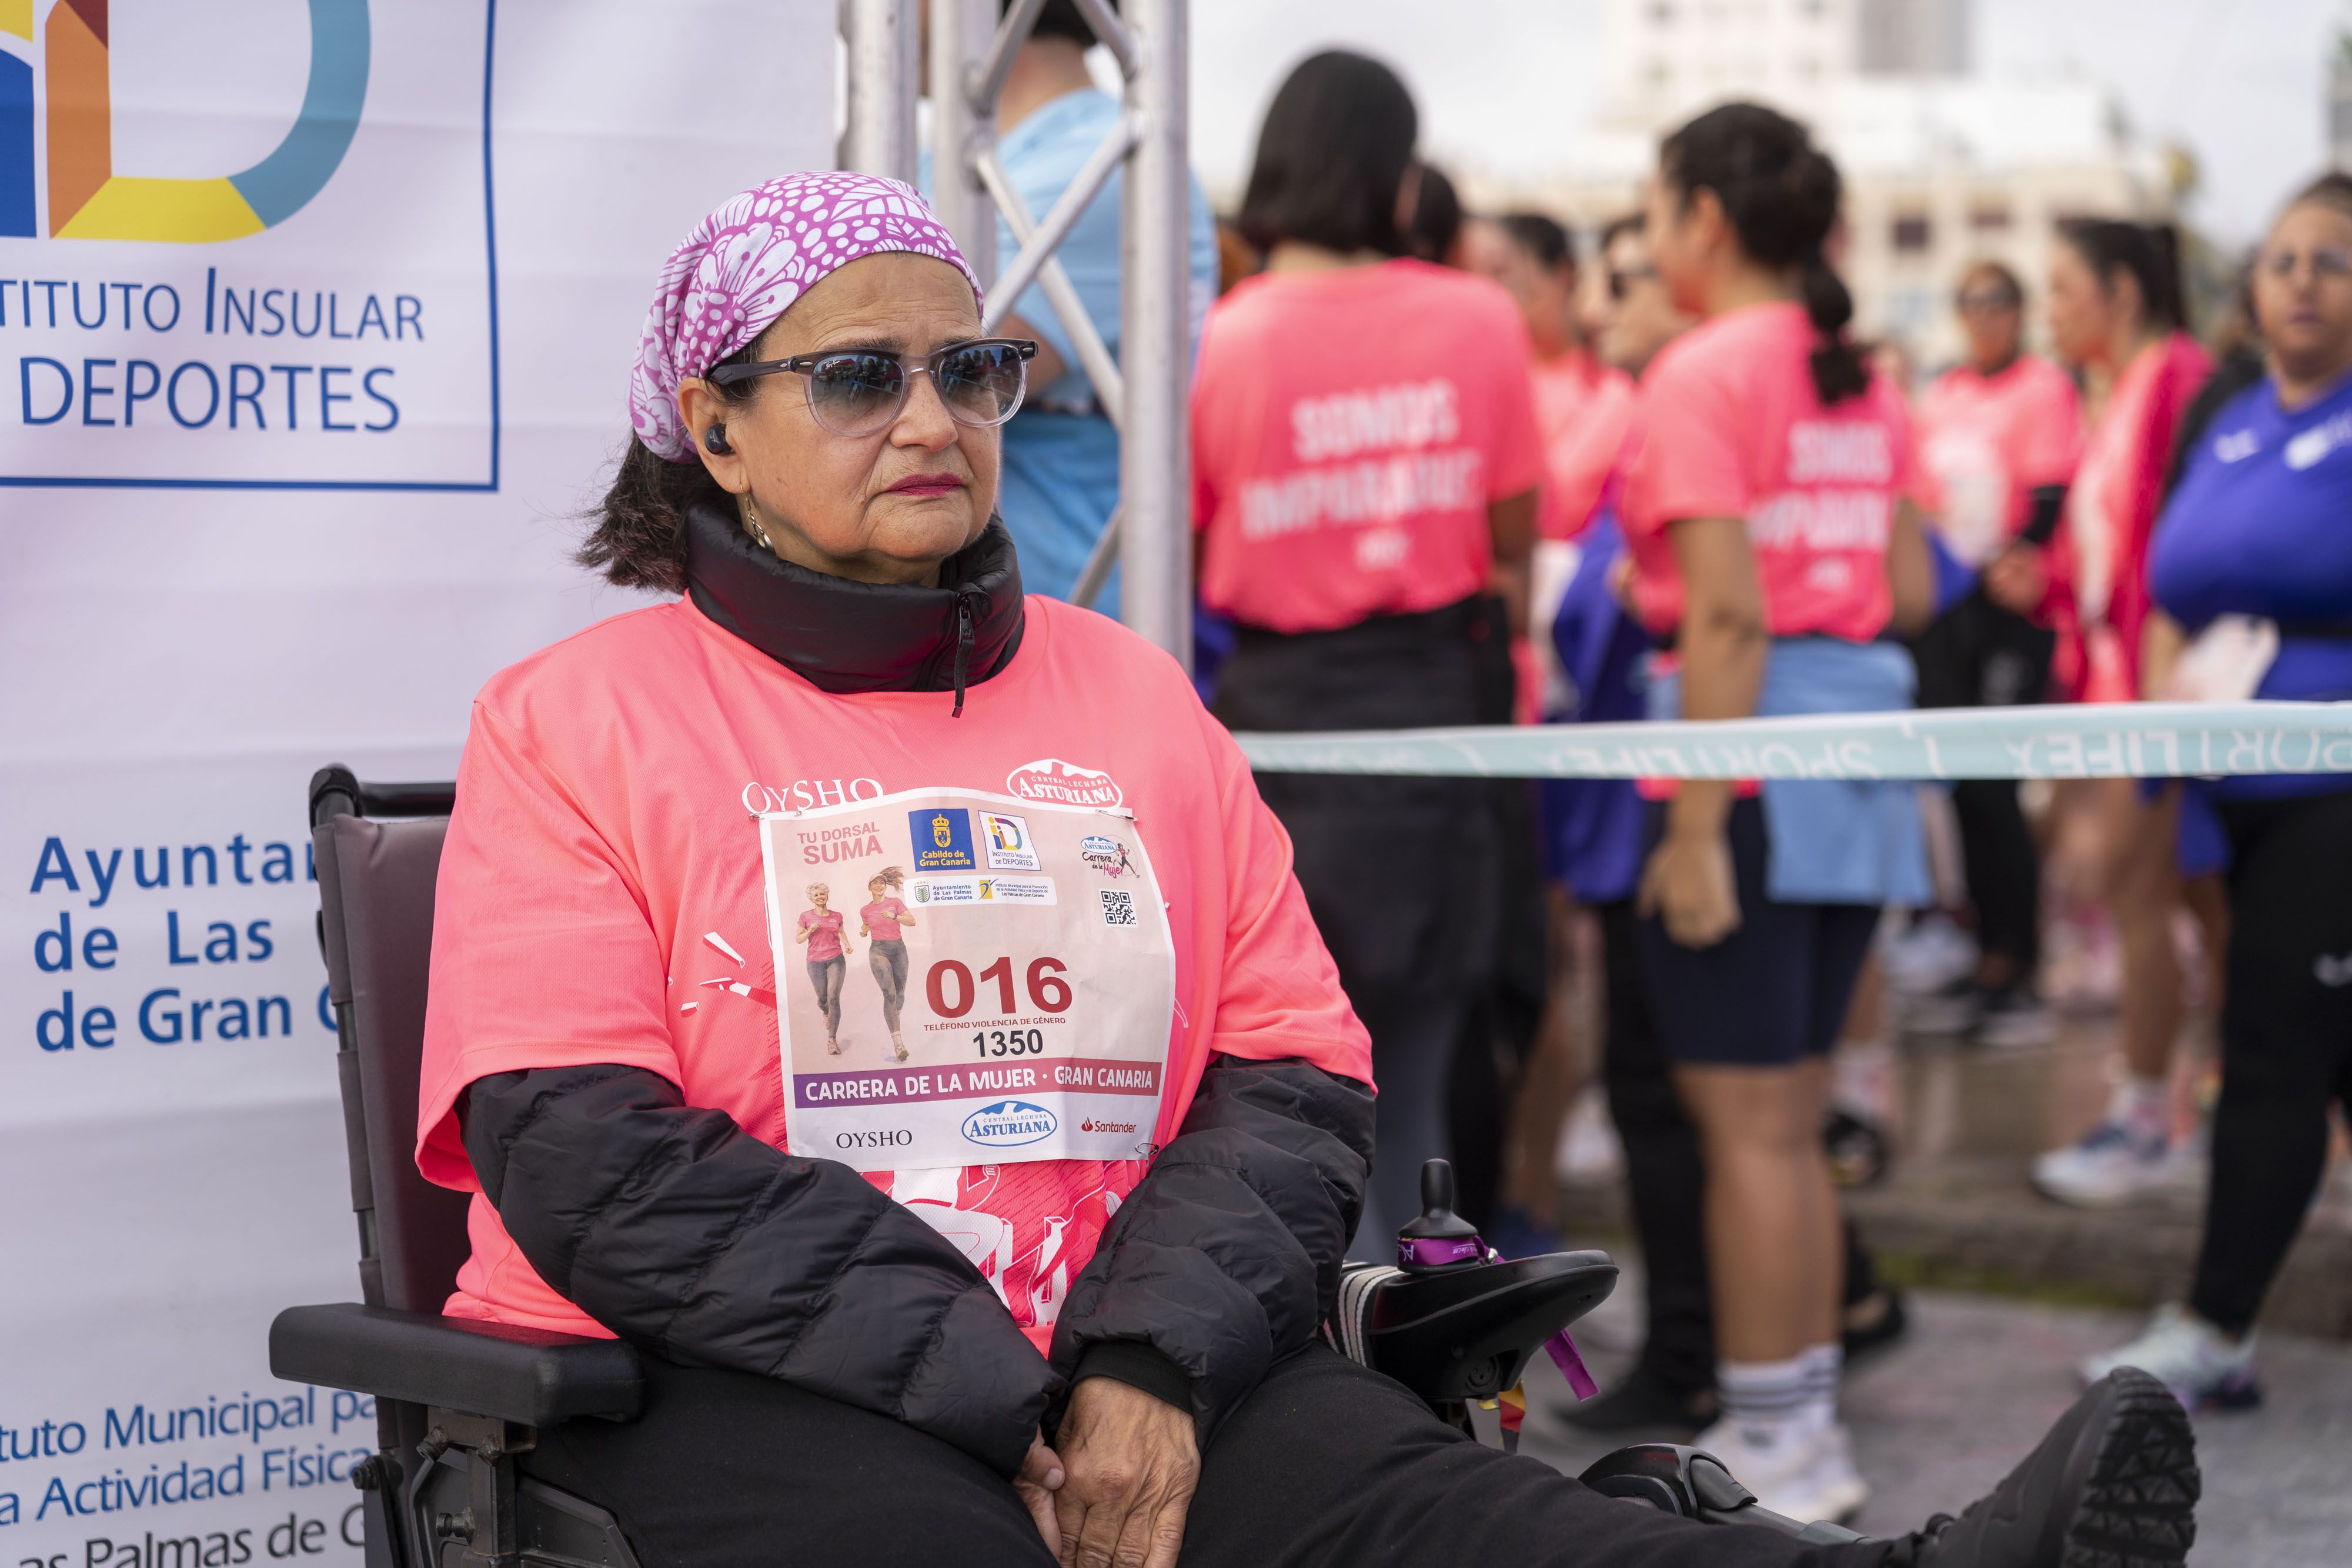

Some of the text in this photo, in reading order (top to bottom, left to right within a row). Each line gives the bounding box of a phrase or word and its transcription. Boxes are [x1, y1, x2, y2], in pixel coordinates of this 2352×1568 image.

[20, 356, 400, 434] DEPORTES
[1020, 777, 1117, 804] ASTURIANA
[1031, 775, 1108, 787] CENTRAL LECHERA
[797, 821, 880, 844] TU DORSAL
[804, 835, 883, 865] SUMA
[921, 850, 953, 858] Cabildo
[1082, 851, 1112, 863] Carrera
[1084, 842, 1115, 850] ASTURIANA
[920, 857, 971, 867] Gran Canaria
[1104, 862, 1124, 878] Mujer
[34, 910, 274, 973] de Las
[926, 957, 1073, 1018] 016
[36, 989, 117, 1052] de
[138, 987, 292, 1045] Gran
[924, 1021, 970, 1031] TELÉFONO
[971, 1018, 1018, 1028] VIOLENCIA
[973, 1029, 1043, 1057] 1350
[806, 1065, 1152, 1101] CARRERA DE LA MUJER GRAN CANARIA
[836, 1129, 913, 1149] OYSHO
[969, 1120, 1051, 1138] ASTURIANA
[1094, 1120, 1137, 1134] Santander
[104, 1385, 316, 1449] Municipal
[35, 1456, 244, 1521] Actividad
[267, 1513, 327, 1559] de
